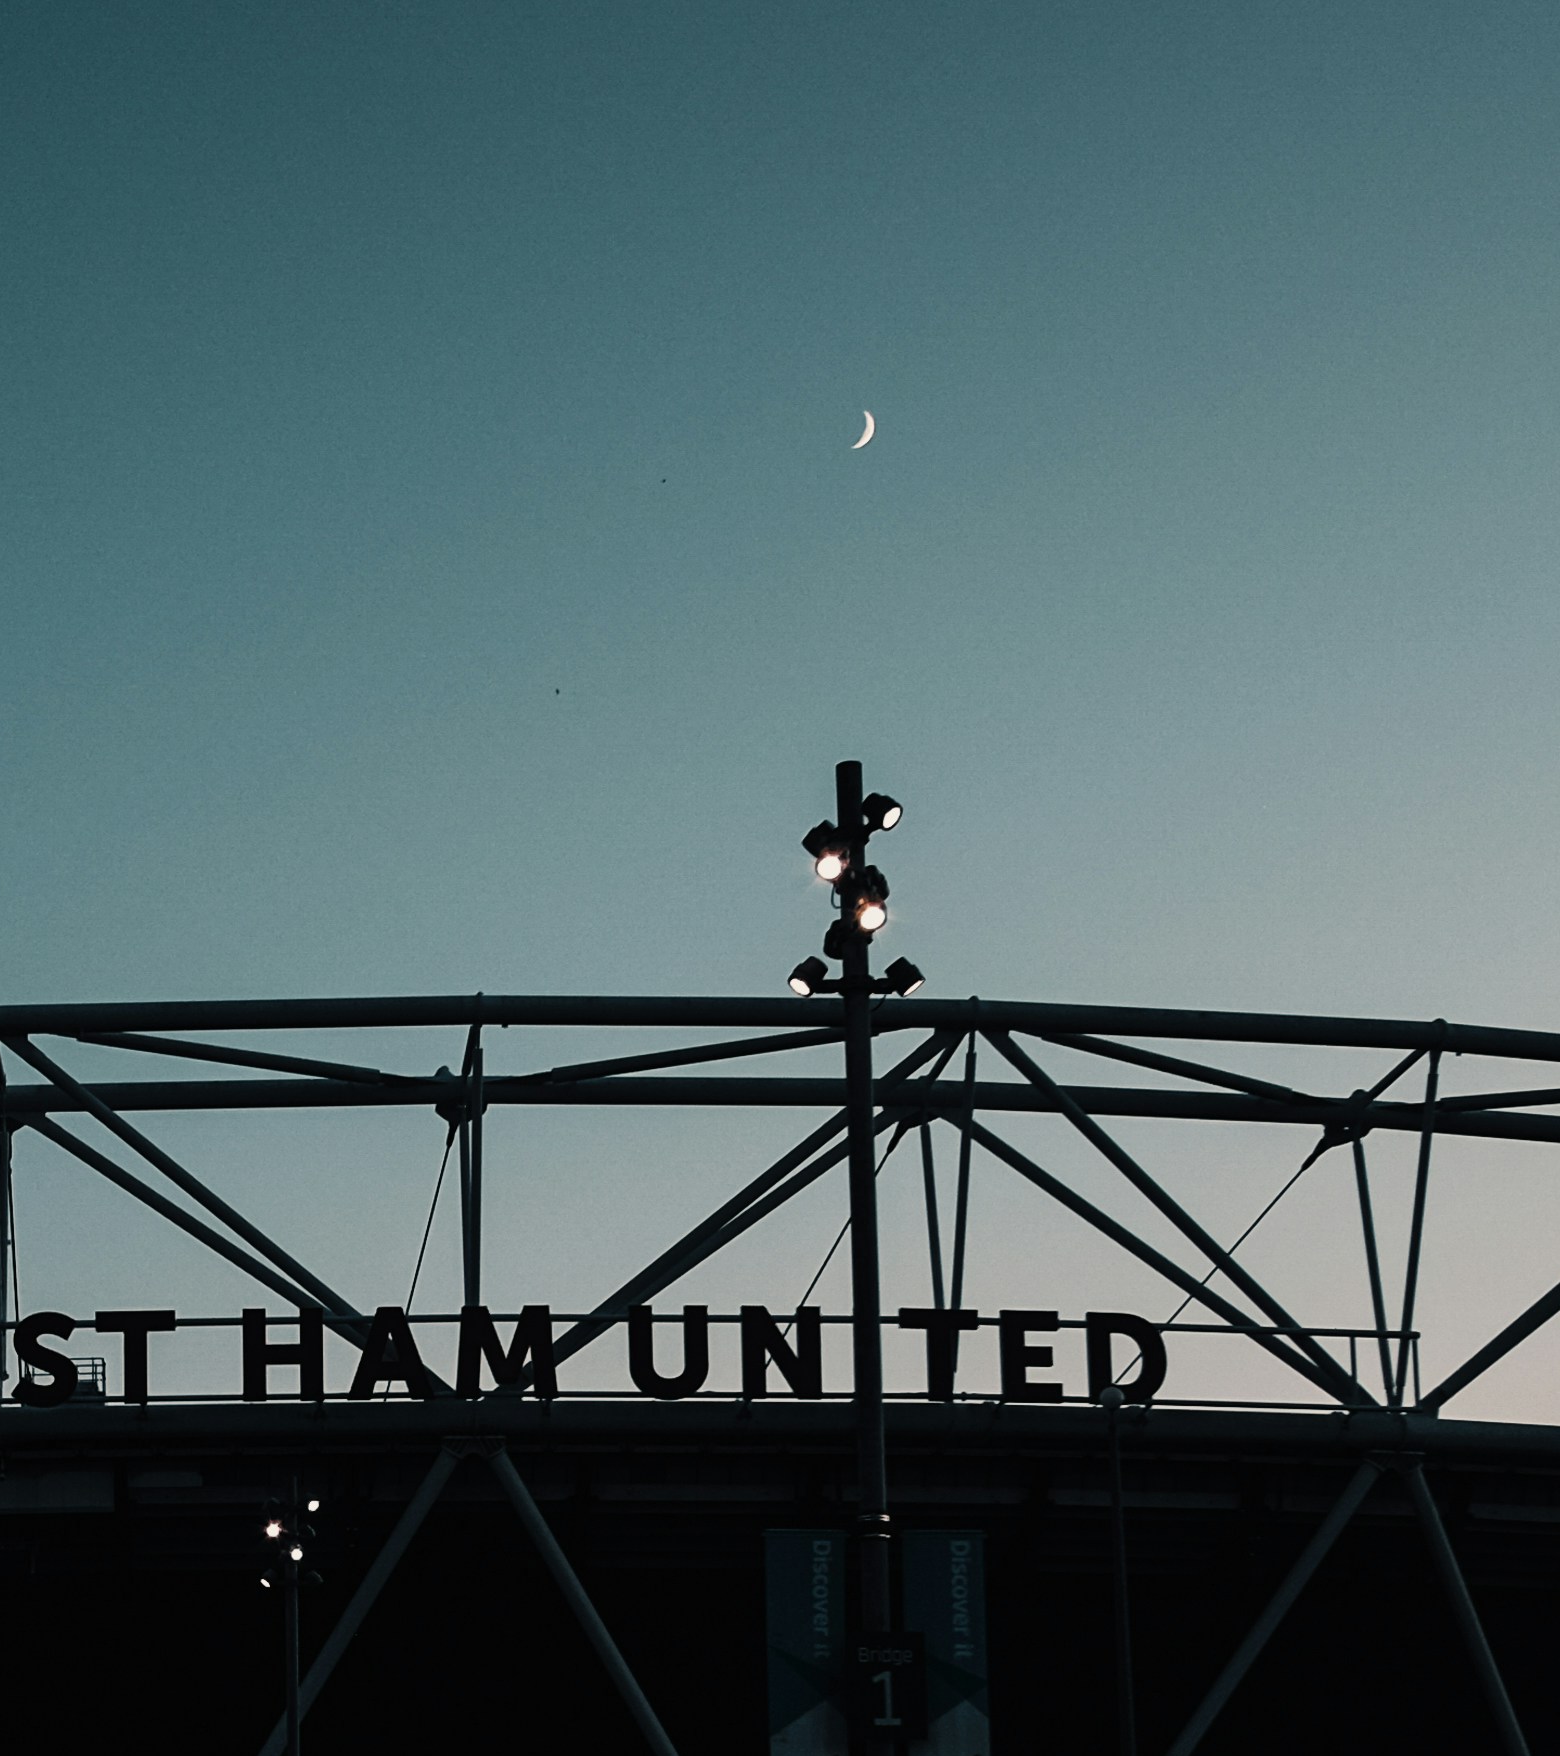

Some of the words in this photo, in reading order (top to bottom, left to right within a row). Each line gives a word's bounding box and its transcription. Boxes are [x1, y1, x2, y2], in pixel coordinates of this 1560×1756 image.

[242, 1304, 558, 1401] HAM
[628, 1304, 1167, 1403] UNTED
[812, 1539, 833, 1637] Discover
[950, 1539, 971, 1637] Discover
[857, 1645, 914, 1667] Bridge
[953, 1643, 975, 1659] it
[871, 1670, 903, 1726] 1
